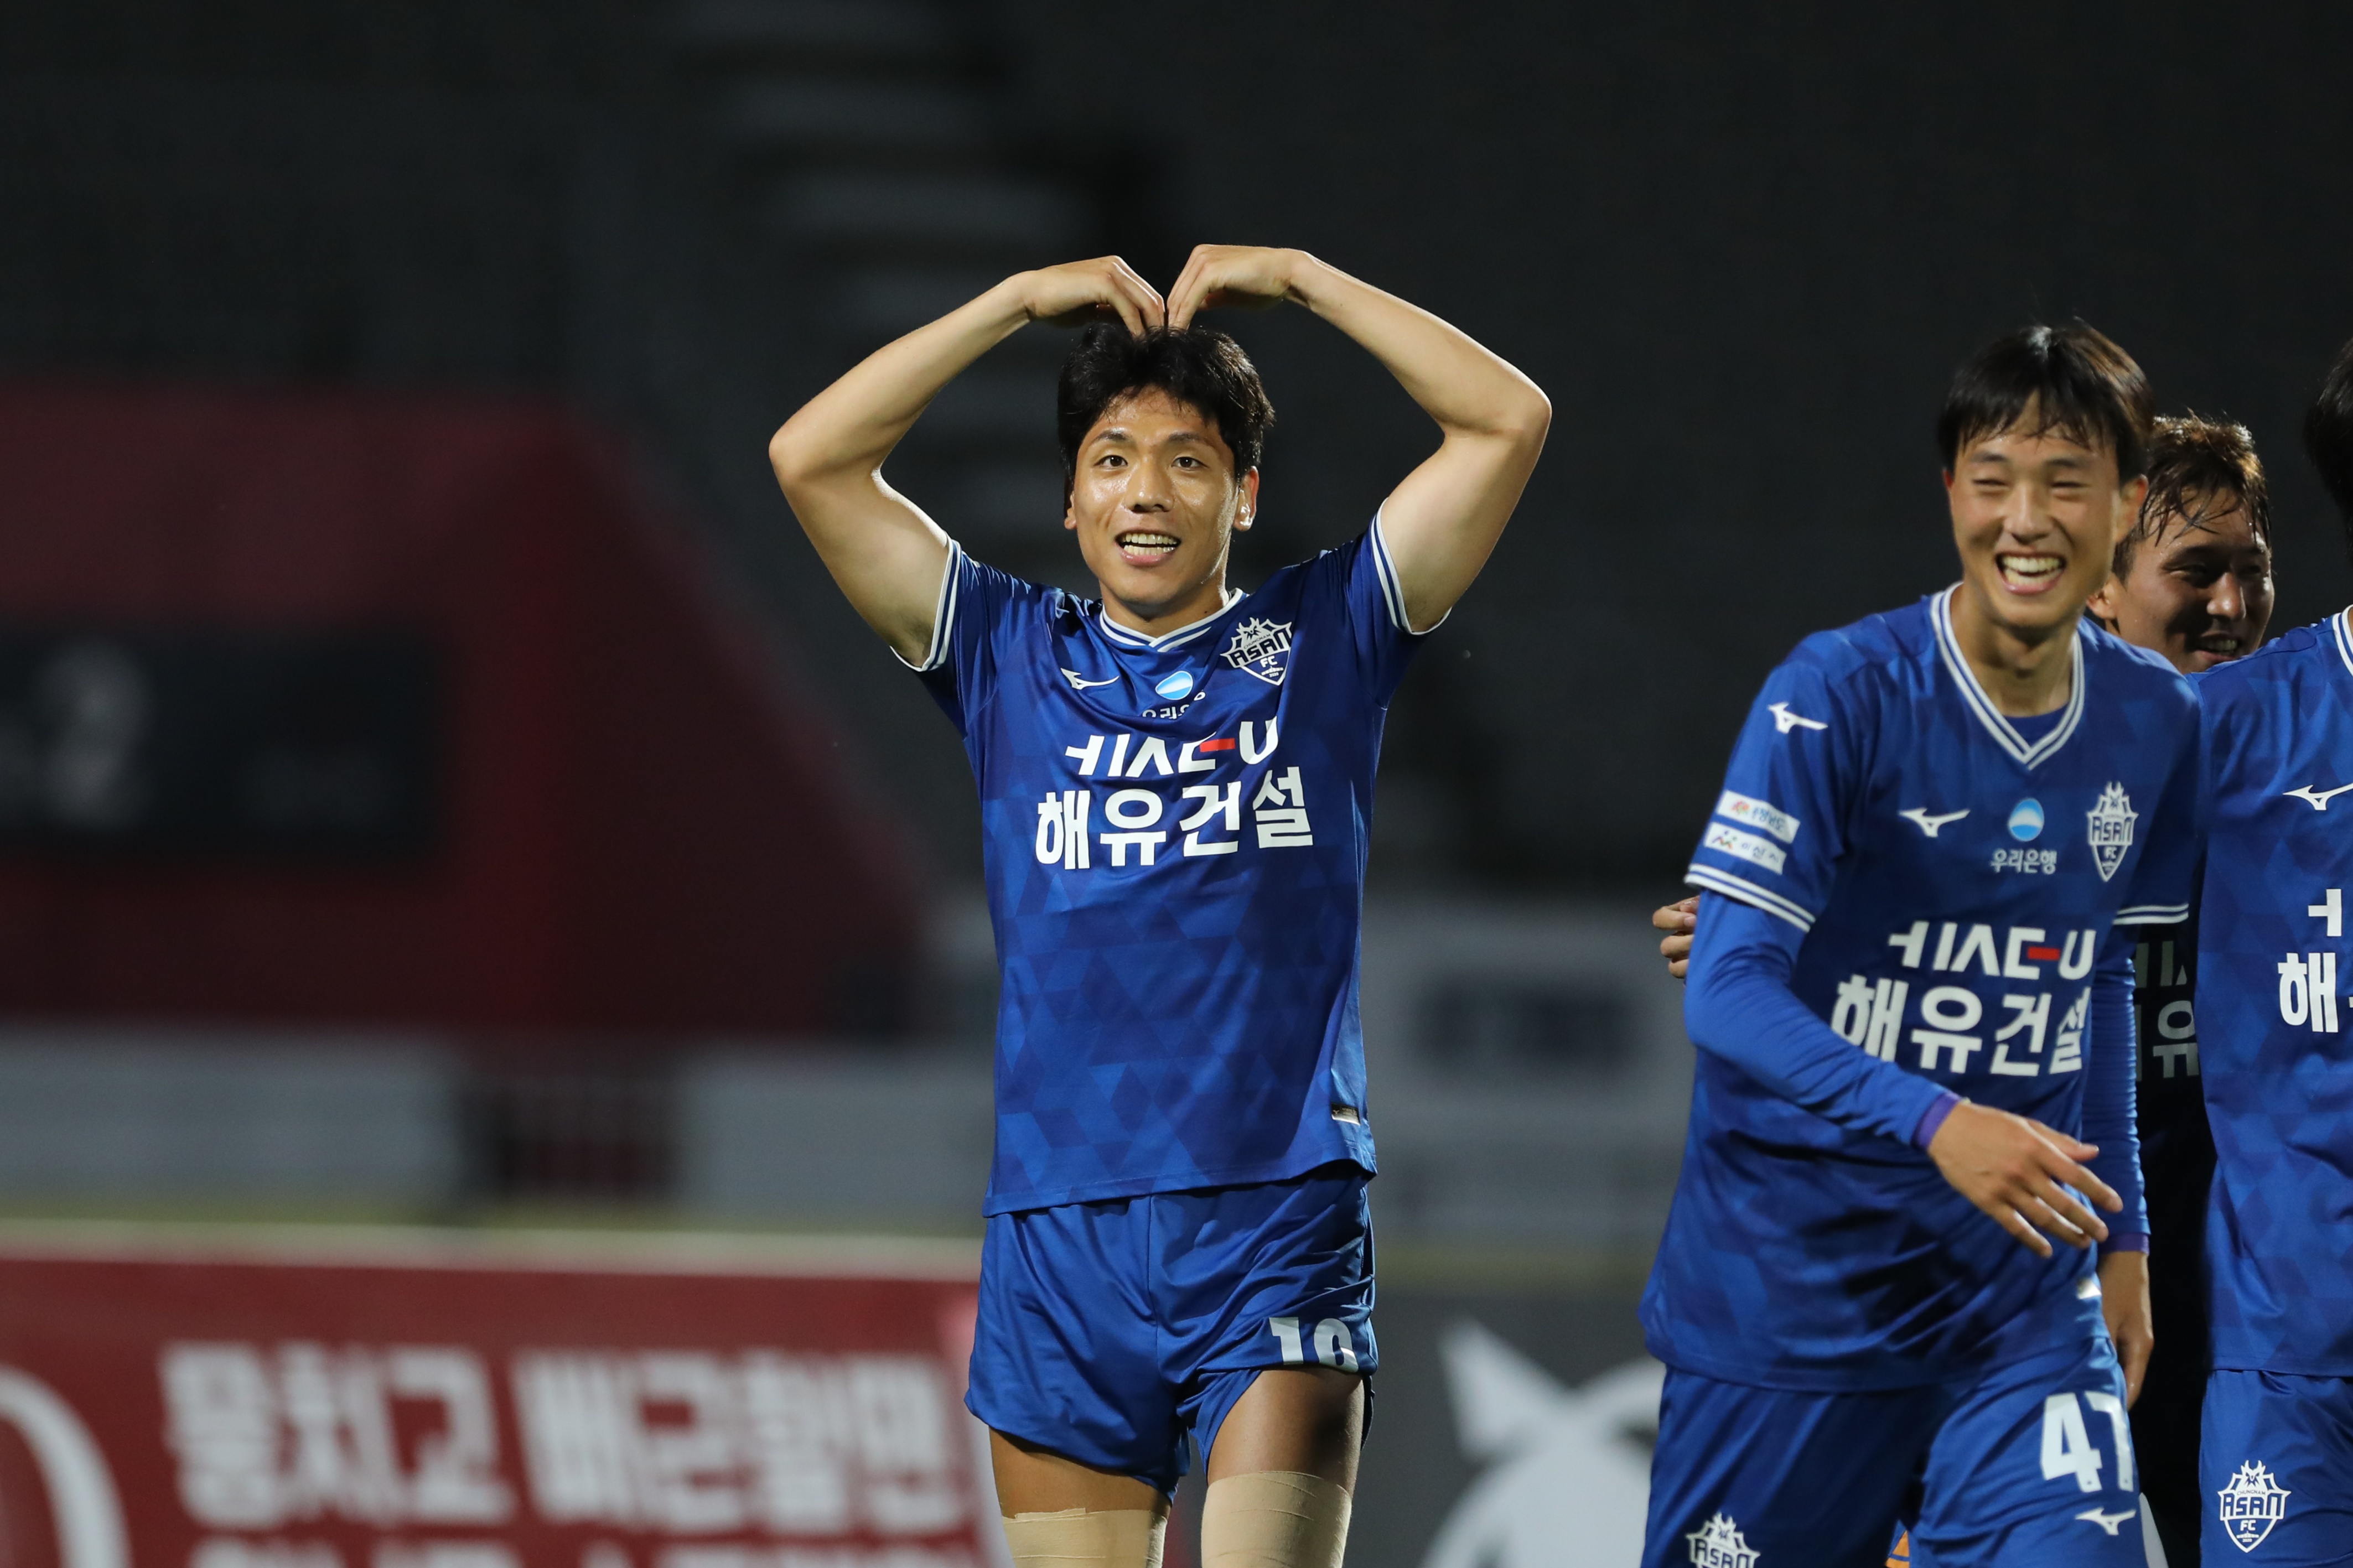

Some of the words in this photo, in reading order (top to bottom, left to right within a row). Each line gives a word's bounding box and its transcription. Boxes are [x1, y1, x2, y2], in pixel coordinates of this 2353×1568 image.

[1229, 627, 1291, 666] ASAN
[1260, 656, 1278, 668] FC
[1035, 766, 1313, 870] 해유건설
[2091, 816, 2132, 842] ASAN
[1991, 848, 2057, 875] 우리은행
[1831, 974, 2091, 1077] 해유건설
[2040, 1390, 2134, 1493] 41
[2222, 1493, 2282, 1518] ASAN
[2240, 1520, 2256, 1531] FC
[1694, 1538, 1750, 1568] ASAN
